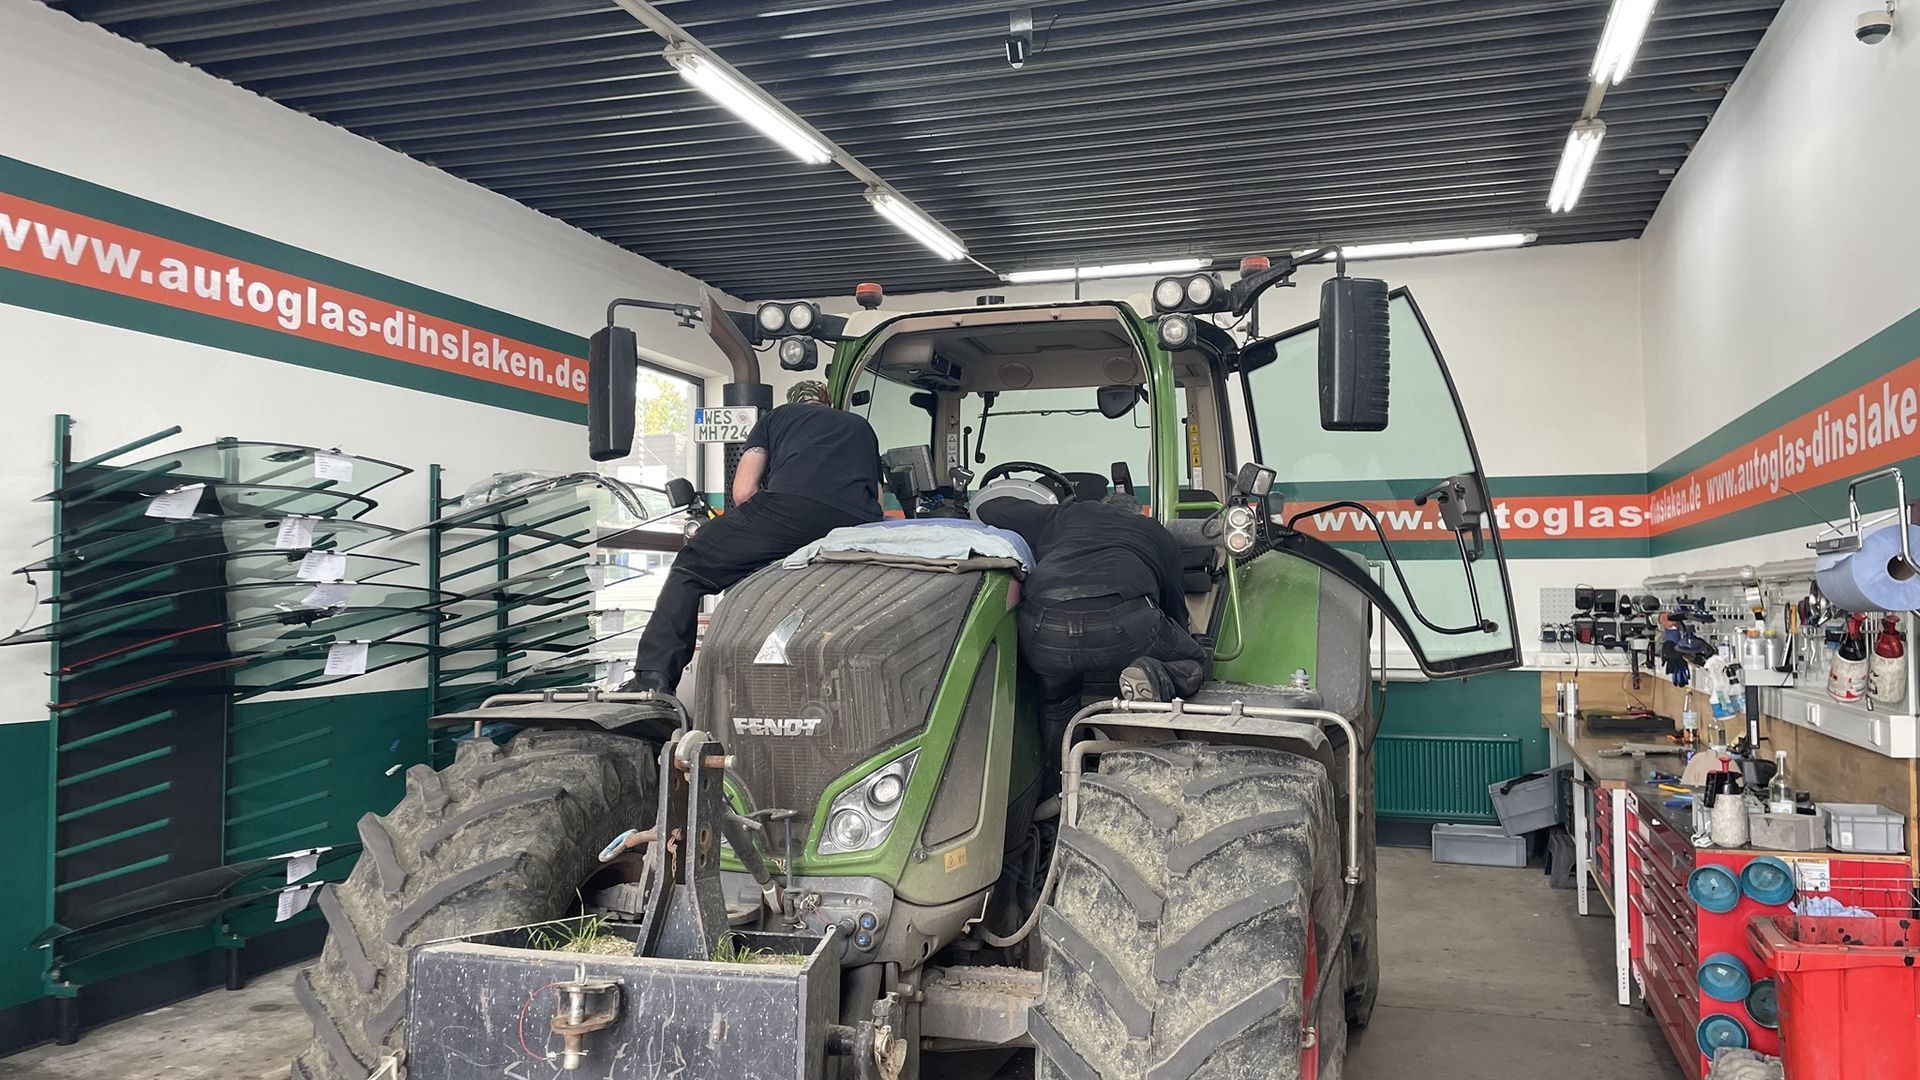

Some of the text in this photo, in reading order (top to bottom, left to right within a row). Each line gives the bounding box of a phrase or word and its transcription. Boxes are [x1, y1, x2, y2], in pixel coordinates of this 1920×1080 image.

[704, 410, 732, 424] WES
[699, 425, 748, 440] MH 724
[1706, 382, 1920, 494] www.autoglas-dinslake
[733, 717, 822, 736] FENDT
